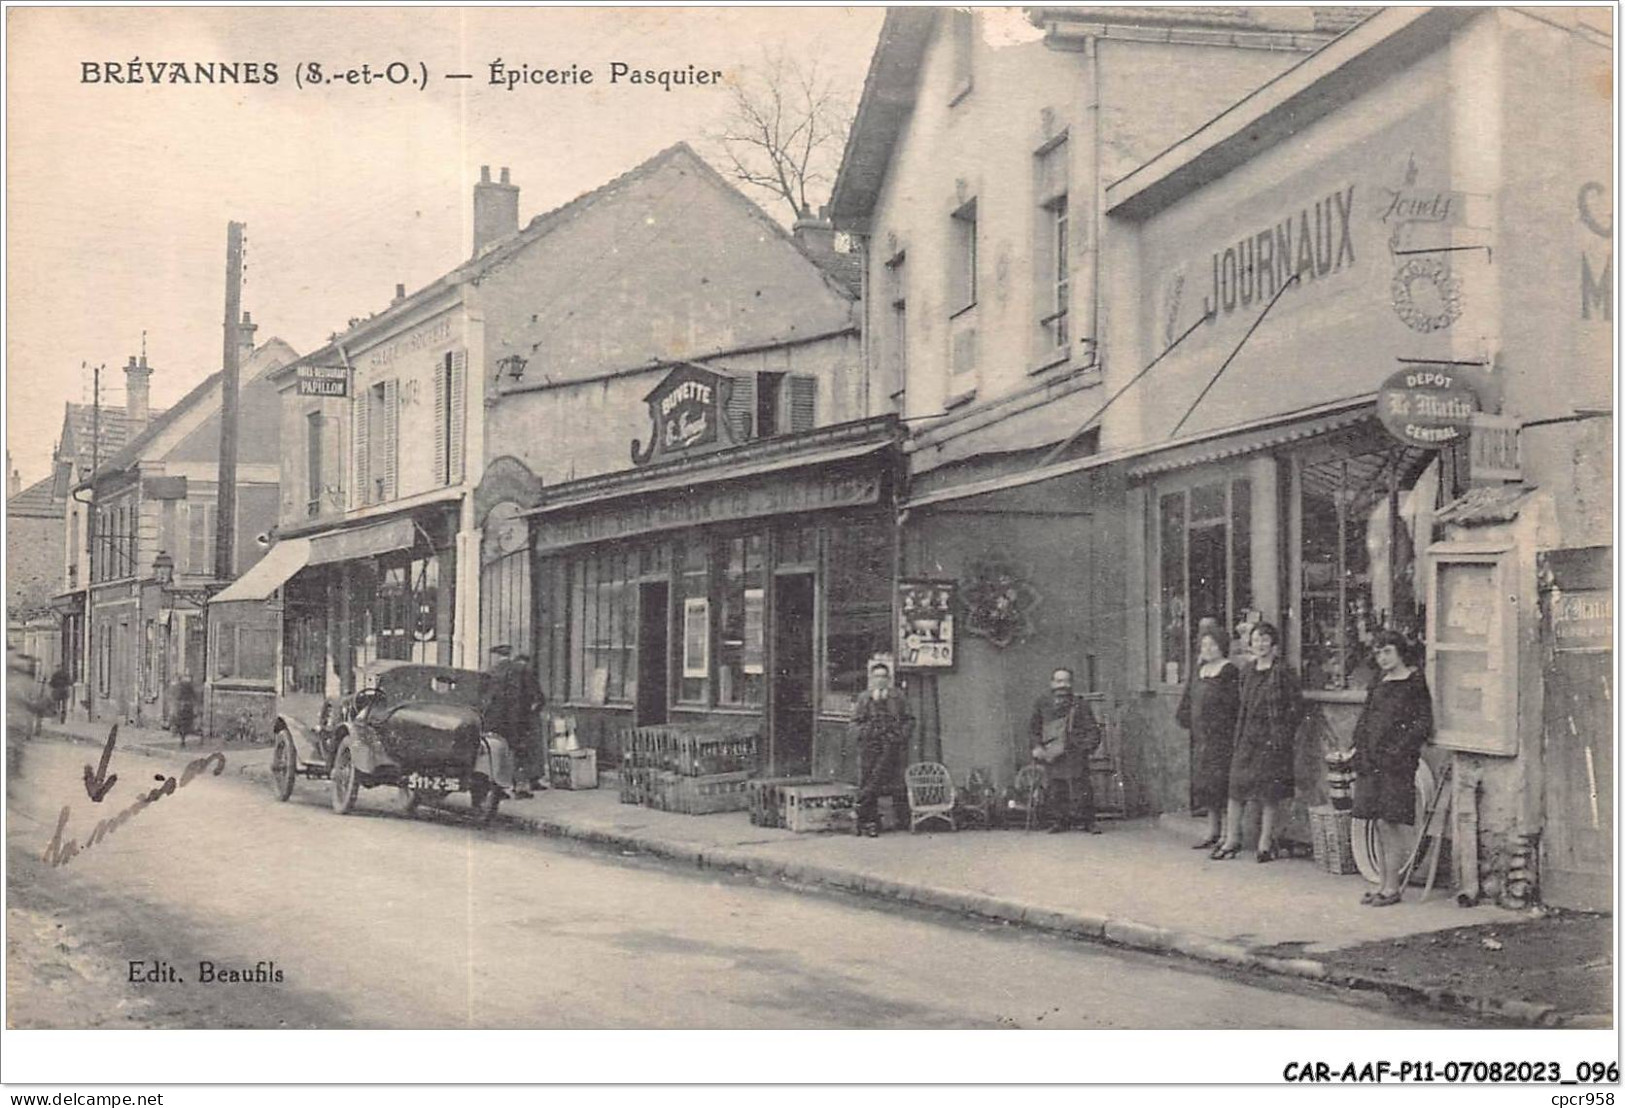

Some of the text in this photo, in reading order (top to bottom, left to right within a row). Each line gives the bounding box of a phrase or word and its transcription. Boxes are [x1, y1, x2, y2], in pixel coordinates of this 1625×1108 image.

[1203, 185, 1355, 323] JOURNAUX
[301, 379, 345, 395] PAPILLON
[661, 381, 712, 416] BUVETTE
[1416, 393, 1472, 418] Matin
[1405, 424, 1460, 442] CENTRAL
